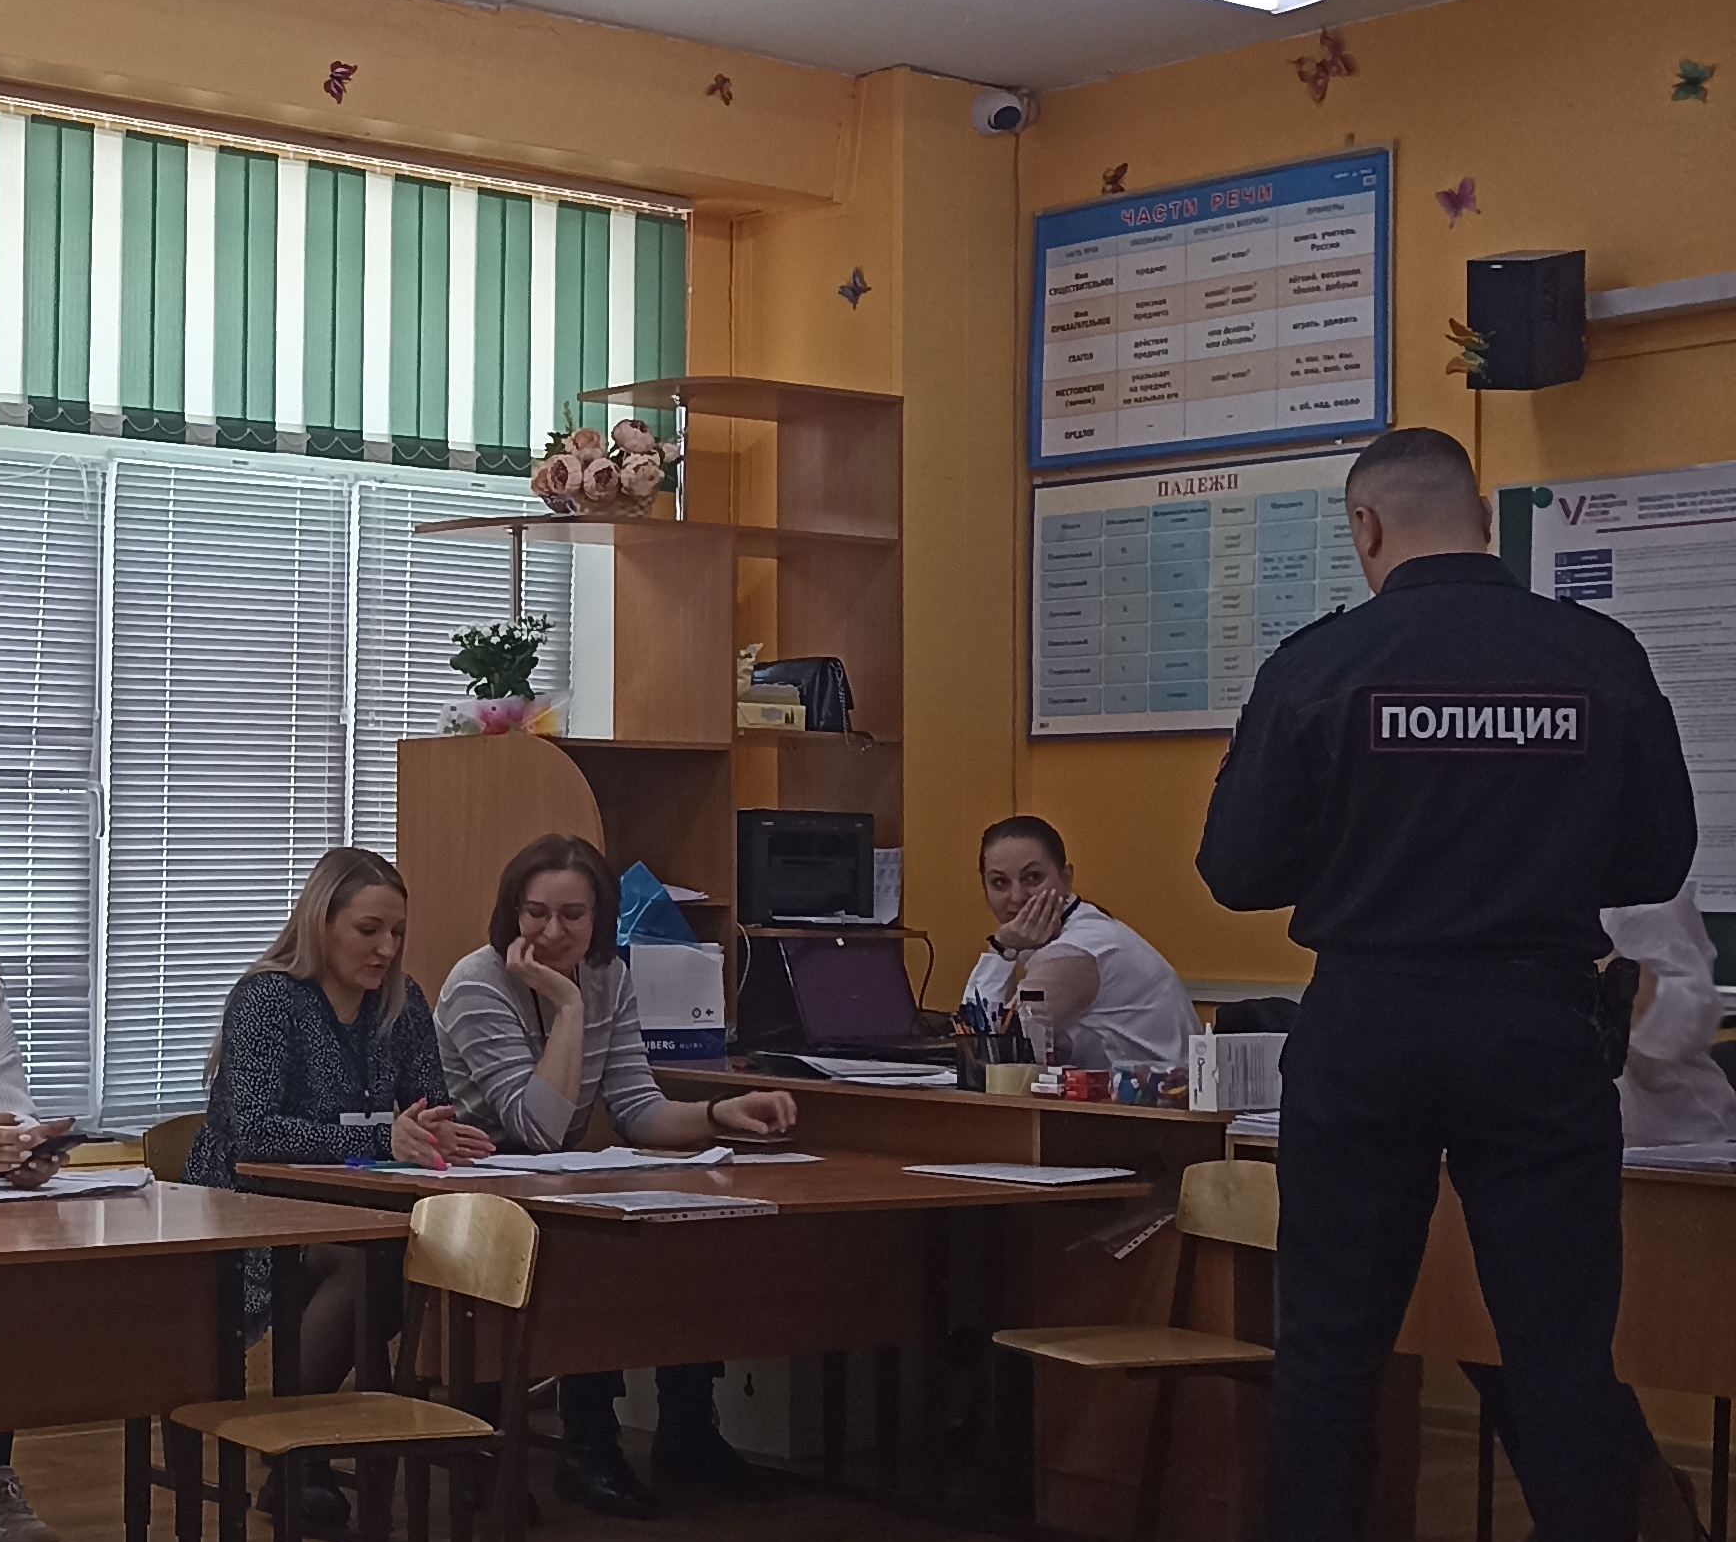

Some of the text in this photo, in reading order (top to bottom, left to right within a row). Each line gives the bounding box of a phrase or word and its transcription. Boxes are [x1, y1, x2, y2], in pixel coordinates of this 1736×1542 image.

[1120, 182, 1273, 227] ЧАСТИ РЕЧИ
[1381, 705, 1577, 745] ПОЛИЦИЯ
